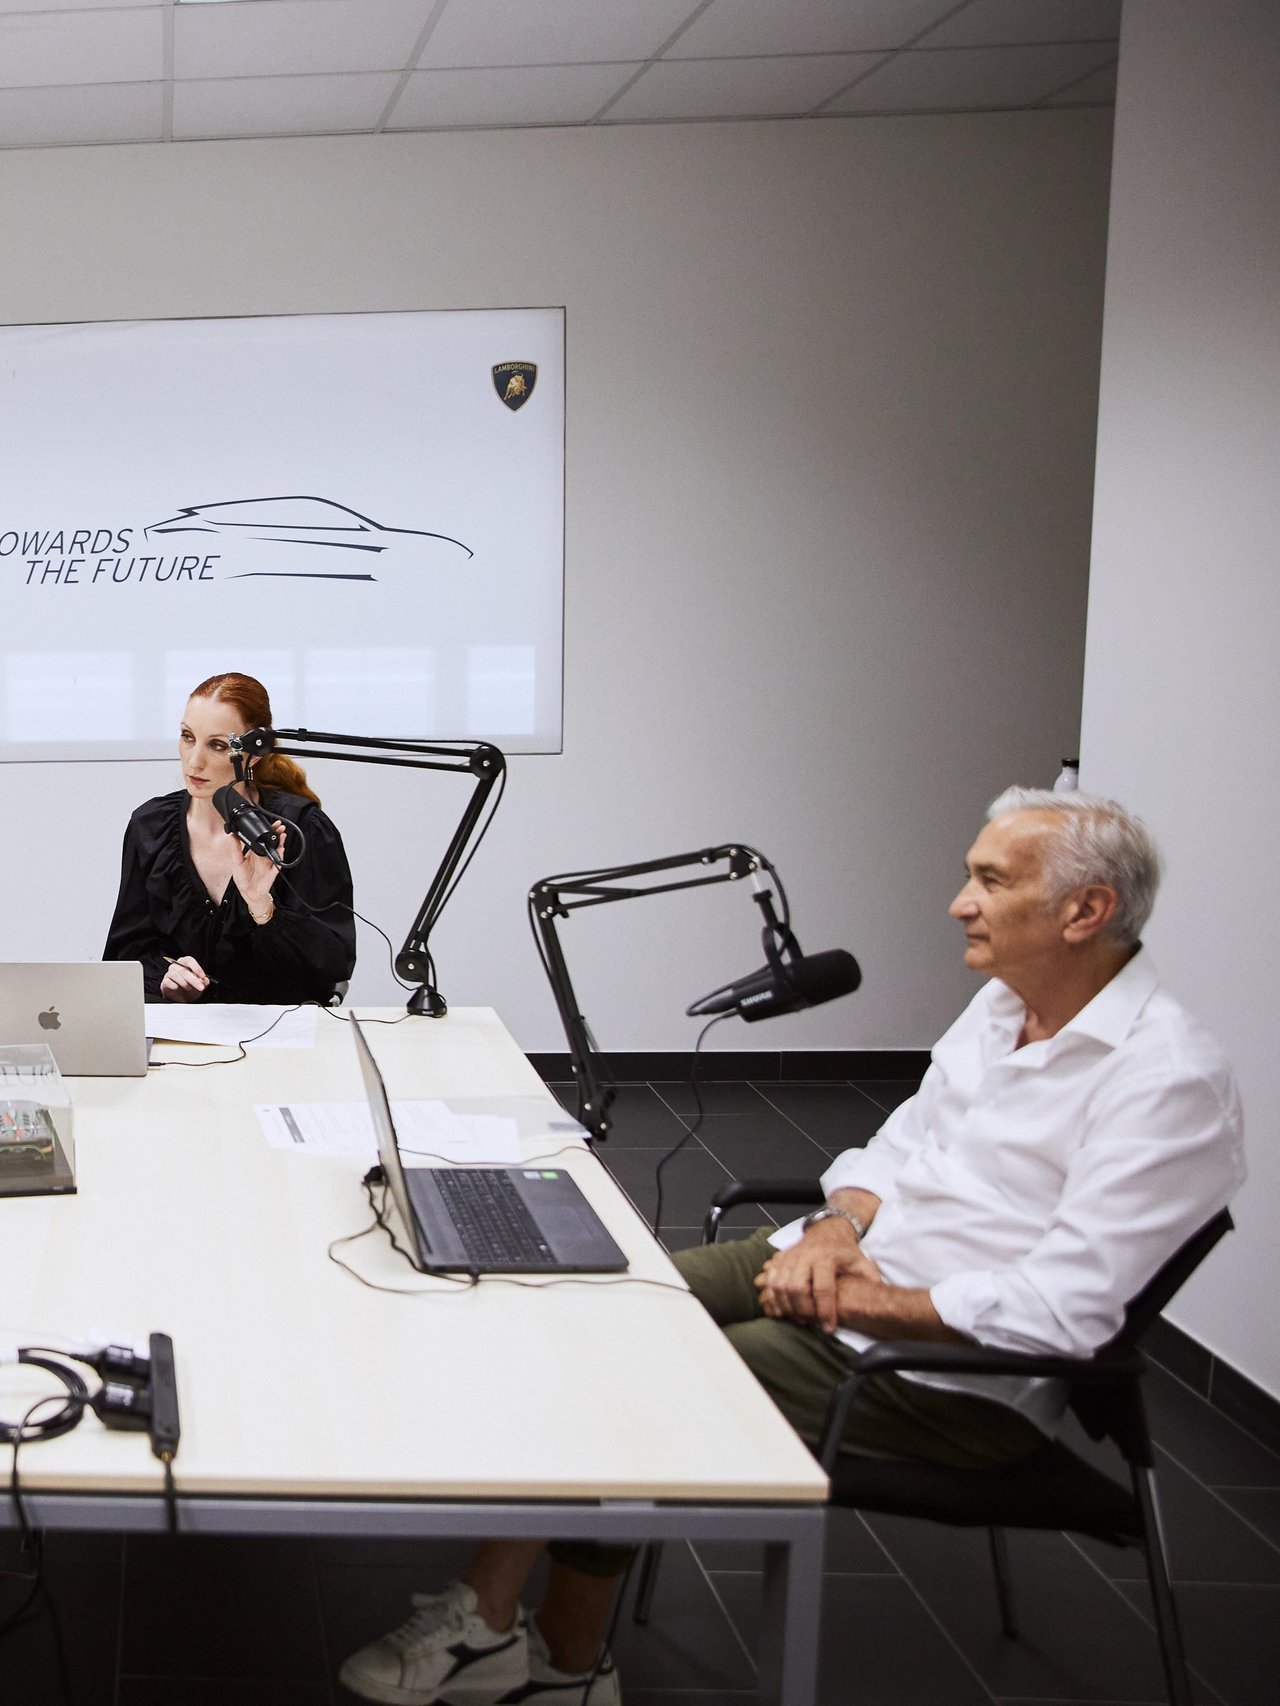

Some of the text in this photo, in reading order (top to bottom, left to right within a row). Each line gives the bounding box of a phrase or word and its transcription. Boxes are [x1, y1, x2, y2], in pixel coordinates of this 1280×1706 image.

[494, 363, 535, 374] LAMBORGHINI
[26, 555, 221, 585] THE FUTURE
